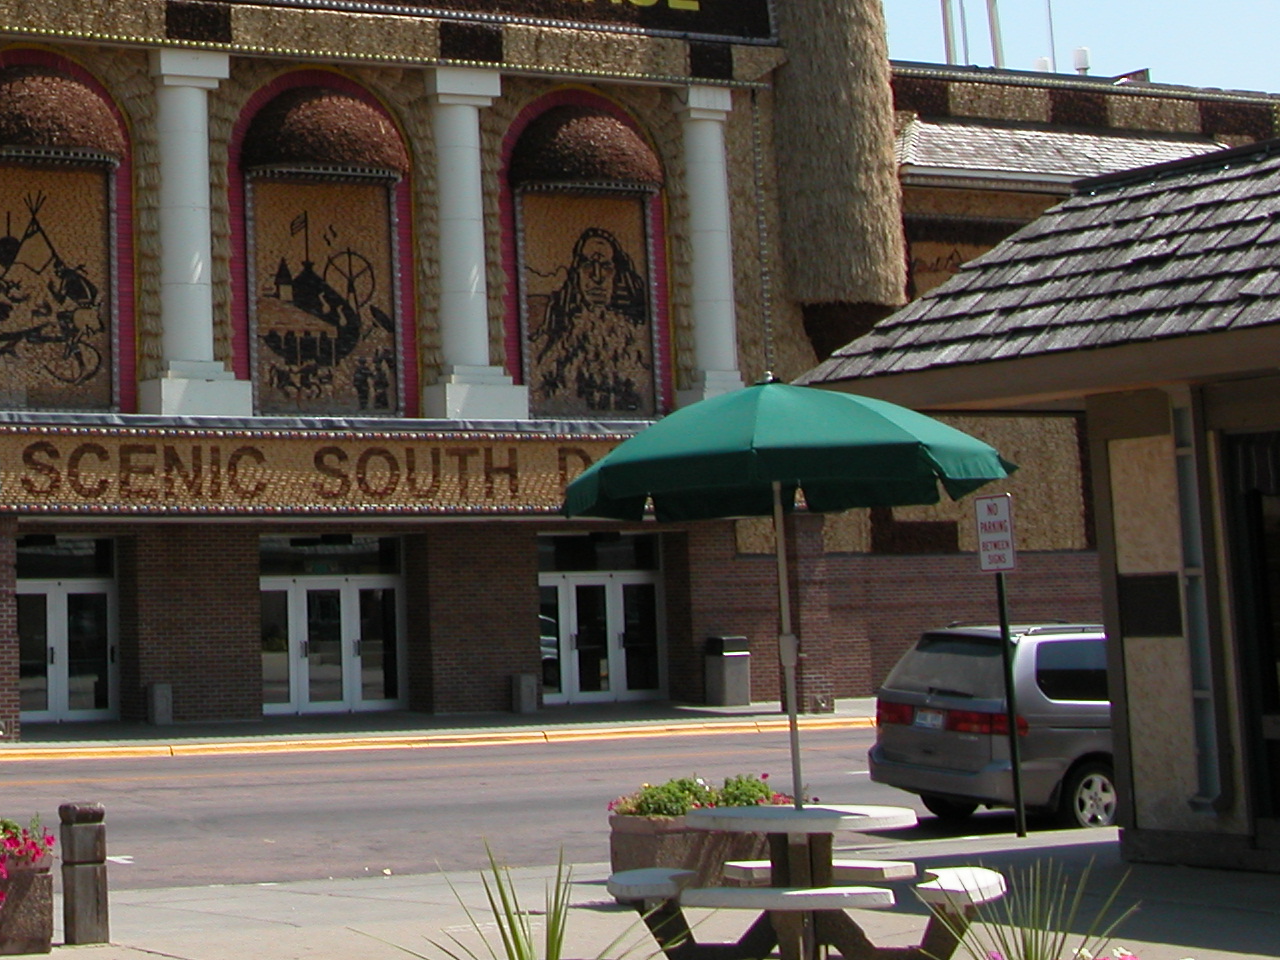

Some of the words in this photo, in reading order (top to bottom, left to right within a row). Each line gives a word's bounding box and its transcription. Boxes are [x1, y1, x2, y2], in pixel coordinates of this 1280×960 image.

[20, 440, 267, 500] SCENIC
[313, 445, 519, 501] SOUTH
[986, 502, 998, 516] NO
[980, 519, 1009, 533] PARKING
[981, 540, 1010, 552] BETWEEN
[987, 553, 1007, 565] SIGNS
